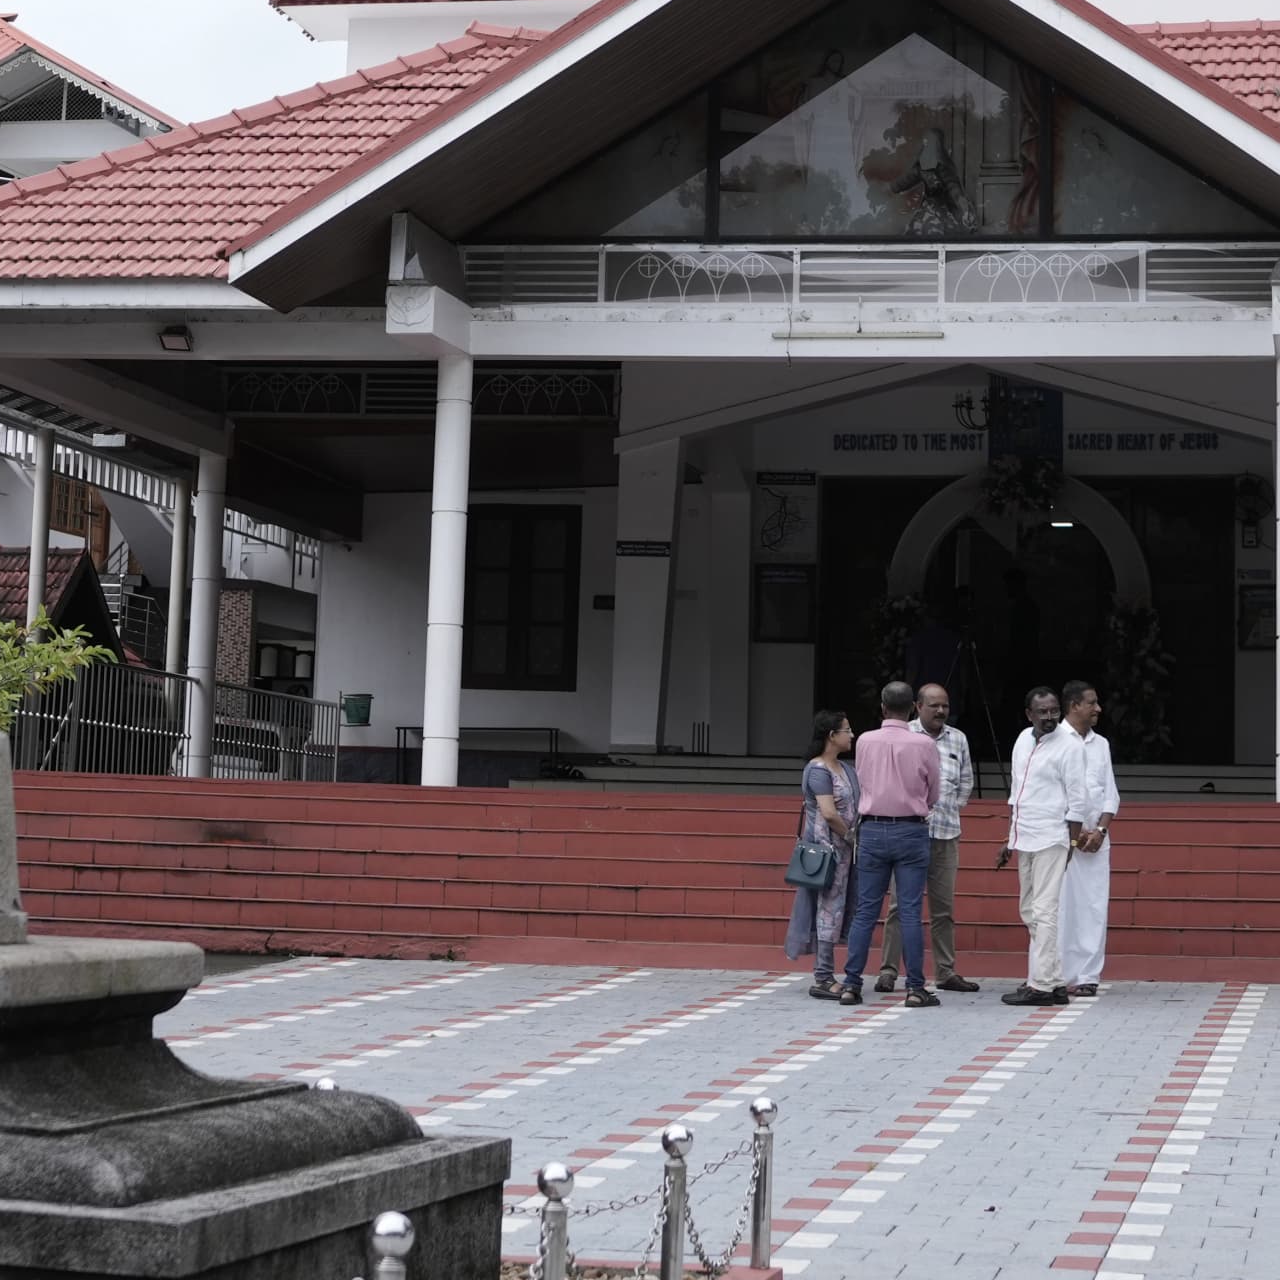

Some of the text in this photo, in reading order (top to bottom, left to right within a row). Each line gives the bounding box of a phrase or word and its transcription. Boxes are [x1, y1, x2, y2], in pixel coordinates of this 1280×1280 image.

[833, 433, 984, 451] DEDICATED TO THE MOST
[1067, 432, 1219, 451] SACRED HEART OF JESUS
